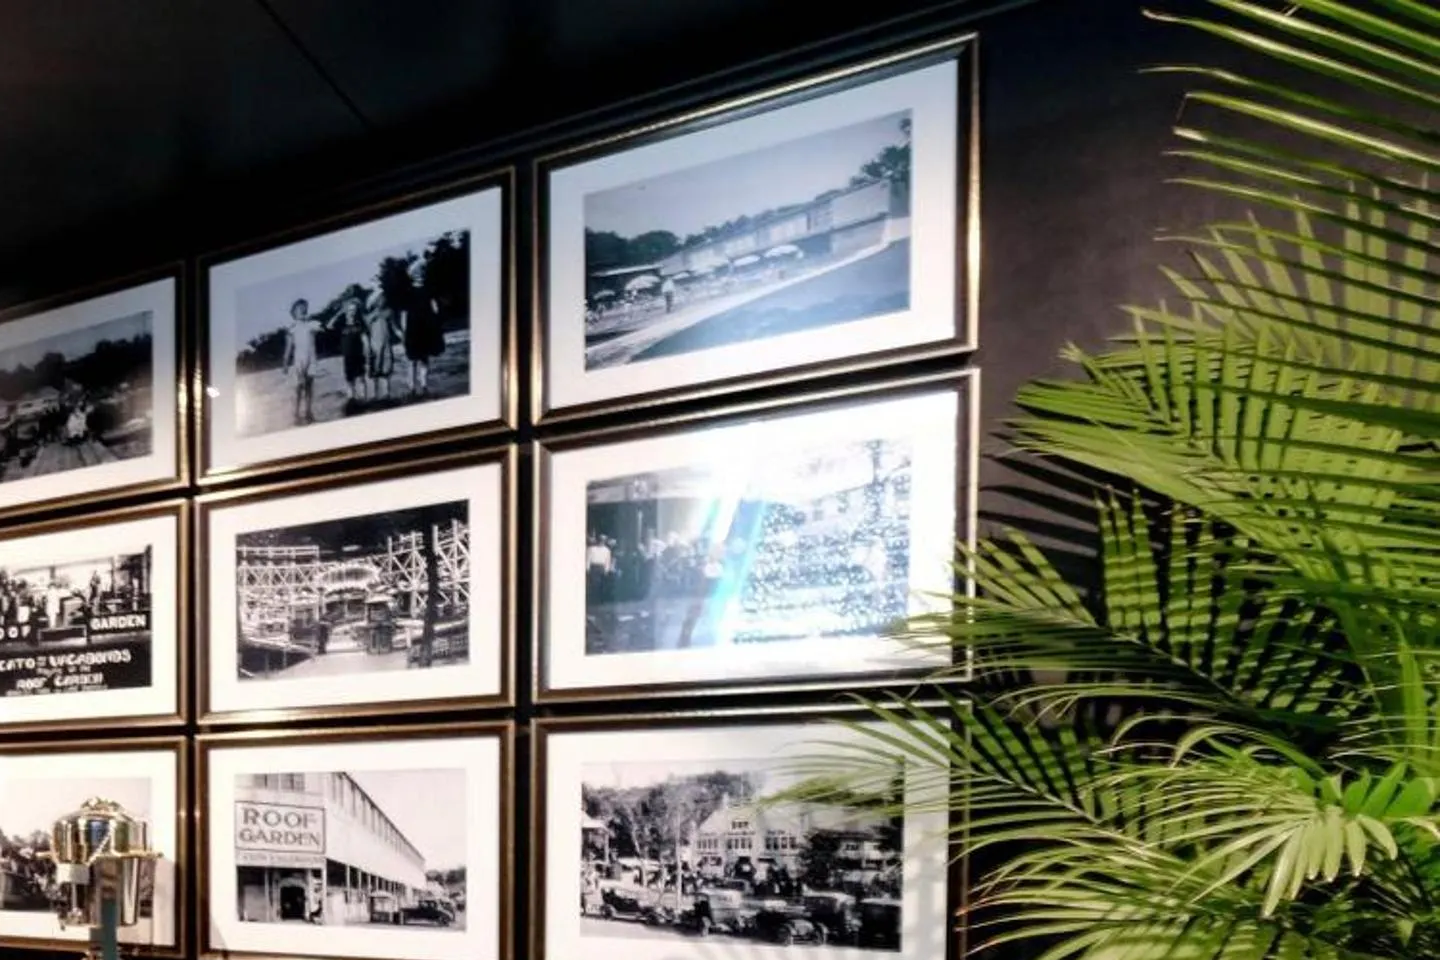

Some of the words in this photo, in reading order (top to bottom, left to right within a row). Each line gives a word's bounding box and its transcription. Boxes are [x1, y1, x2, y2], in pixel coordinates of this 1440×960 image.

[90, 614, 146, 630] GARDEN
[242, 807, 317, 829] ROOF
[239, 828, 322, 846] GARDEN
